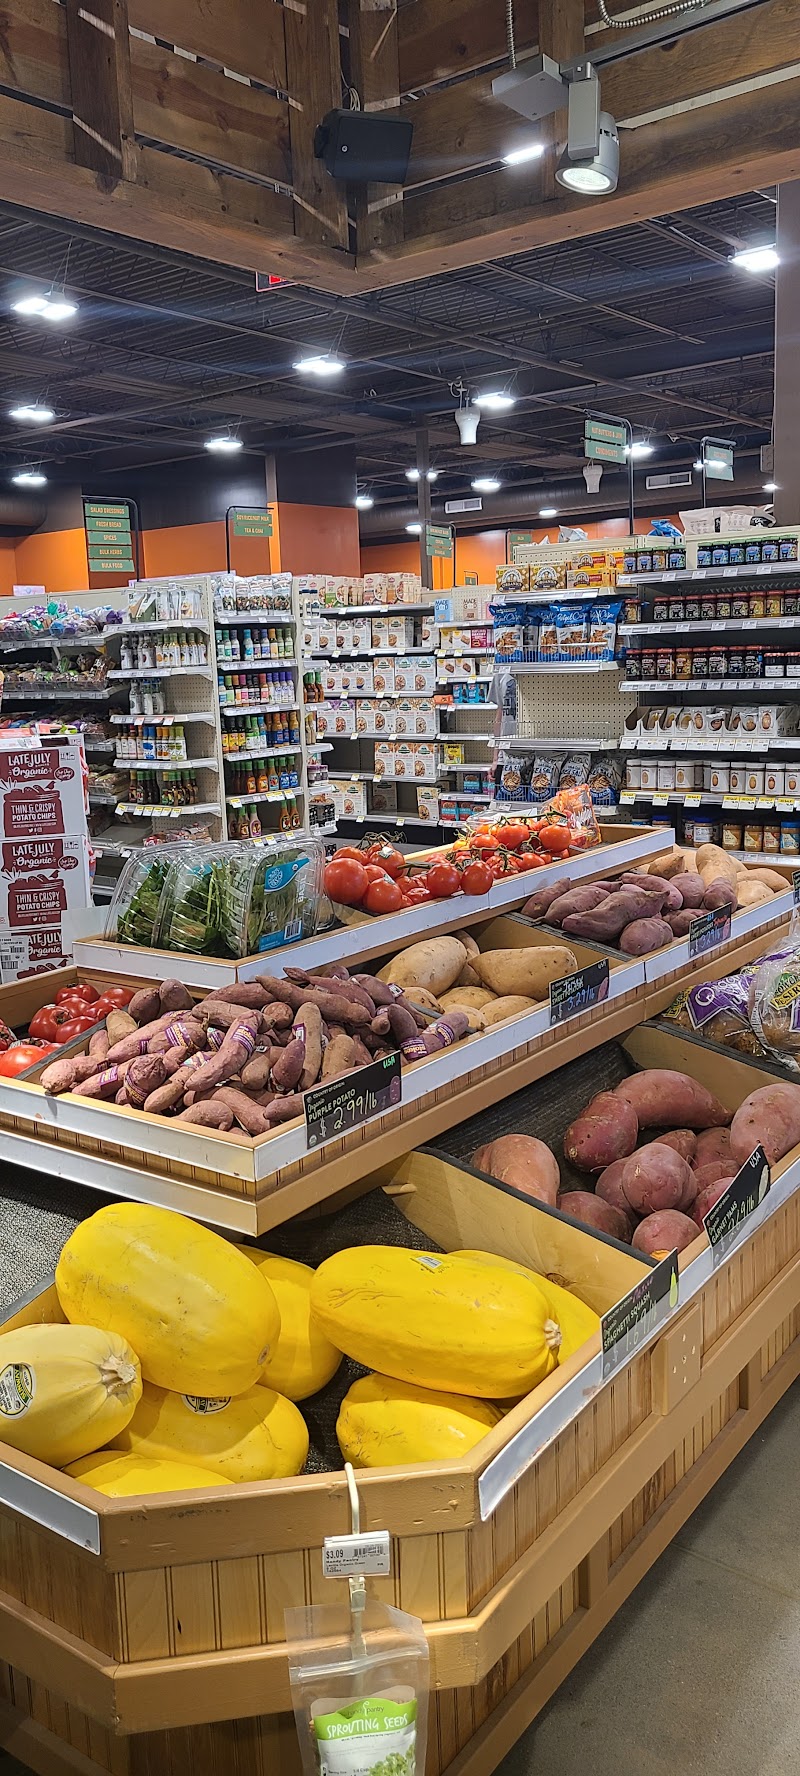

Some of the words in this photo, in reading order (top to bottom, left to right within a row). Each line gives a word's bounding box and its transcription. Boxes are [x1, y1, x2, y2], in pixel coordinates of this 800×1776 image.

[12, 767, 48, 778] Organic
[11, 804, 27, 814] THIN
[28, 804, 35, 813] &
[35, 803, 55, 812] CRISPY
[16, 856, 52, 868] Organic
[298, 874, 307, 903] BASIL
[16, 894, 31, 904] THIN
[39, 891, 60, 901] CRISPY
[16, 902, 40, 911] POTATO
[29, 934, 42, 944] ATE
[383, 1056, 395, 1069] USA
[313, 1090, 328, 1098] COUNTRY
[308, 1099, 325, 1113] Organic
[309, 1102, 332, 1122] PURPLE
[333, 1089, 355, 1109] POTATO
[320, 1116, 326, 1137] $
[334, 1090, 377, 1130] 2.99/lb
[749, 1152, 761, 1168] USA
[712, 1216, 726, 1243] GARNET
[726, 1201, 737, 1217] YAMS
[604, 1316, 630, 1349] SPAGHETTI
[630, 1291, 650, 1318] SQUASH
[326, 1549, 344, 1559] $3.09
[367, 1706, 384, 1716] pantry
[326, 1719, 379, 1738] SPROUTING
[384, 1714, 408, 1730] SEEDS
